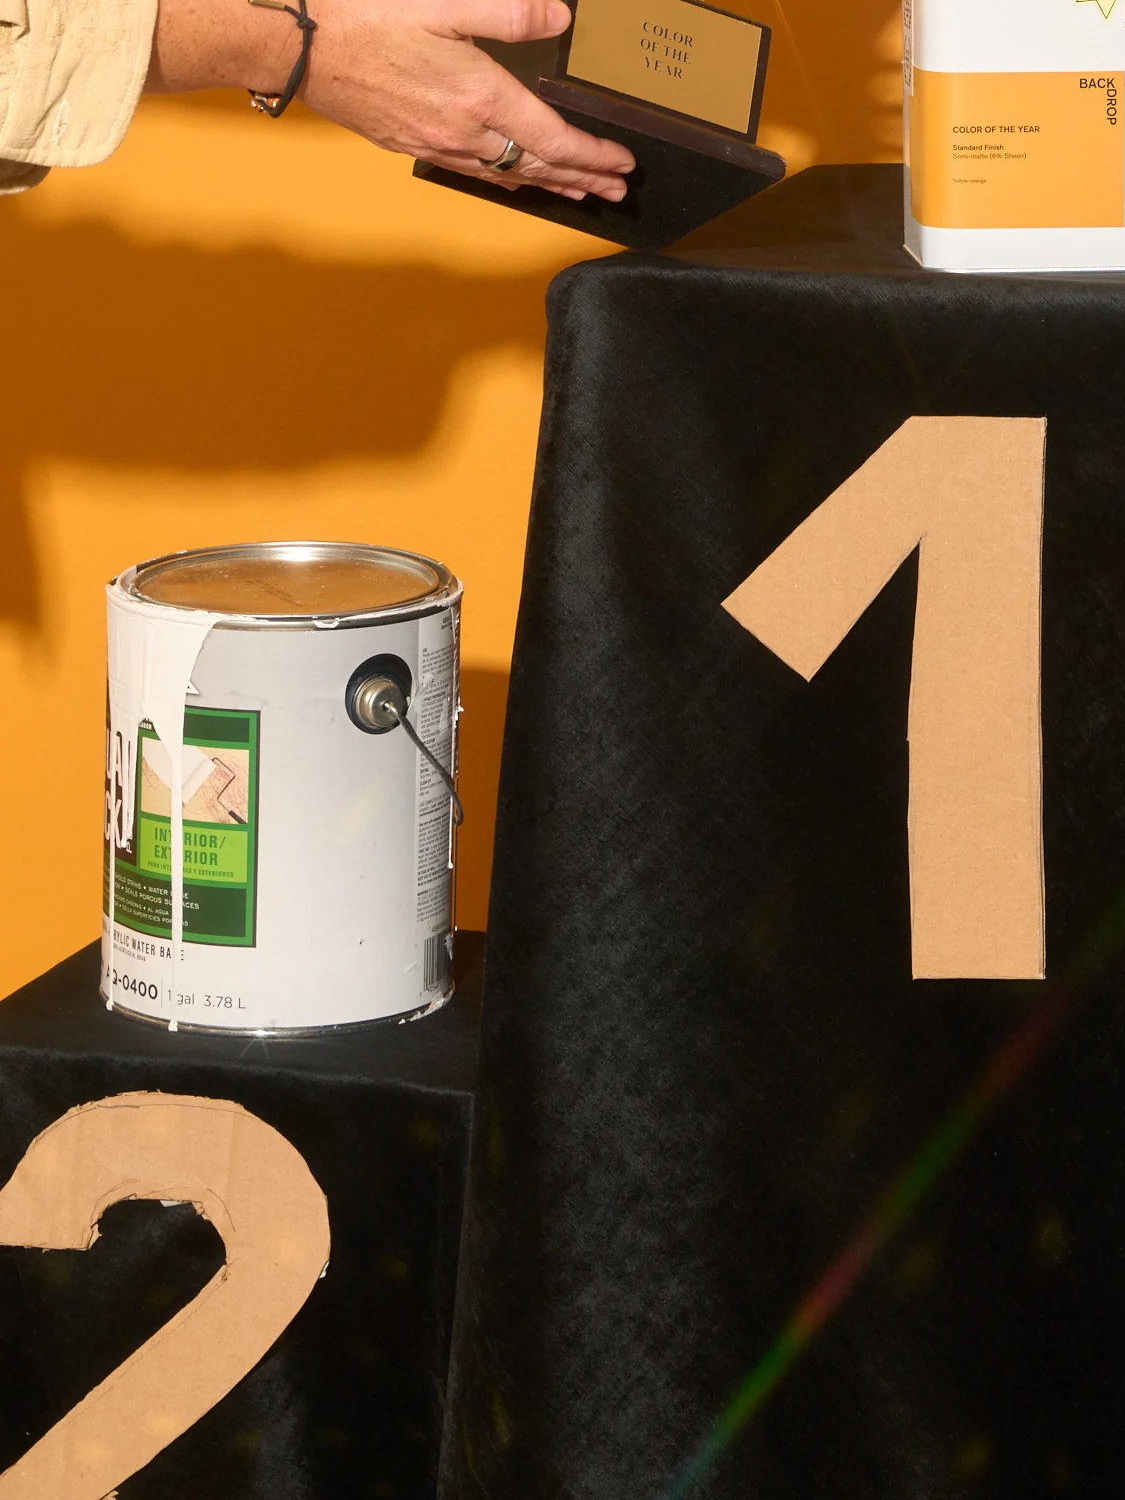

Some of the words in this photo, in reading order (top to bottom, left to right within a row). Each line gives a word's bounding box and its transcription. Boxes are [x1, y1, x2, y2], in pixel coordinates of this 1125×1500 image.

[643, 21, 693, 47] COLOR
[640, 38, 658, 53] OF
[663, 45, 692, 64] THE
[643, 56, 683, 79] YEAR
[1079, 77, 1115, 89] BACK
[1106, 89, 1117, 126] DROP
[952, 126, 982, 134] COLOR
[1004, 152, 1026, 160] Sheen)
[720, 415, 1047, 980] 1
[154, 827, 226, 848] INRIOR/
[154, 845, 218, 866] EXRIOR
[199, 869, 234, 878] EXTERIORES
[125, 886, 138, 898] SEALS
[139, 892, 162, 904] POROUS
[164, 898, 199, 910] SUACES
[148, 886, 168, 895] WATER
[132, 936, 156, 956] WATER
[160, 946, 184, 961] BA
[176, 993, 195, 1006] gal
[204, 995, 233, 1009] 3.78
[238, 998, 247, 1009] L
[0, 1089, 331, 1500] 2
